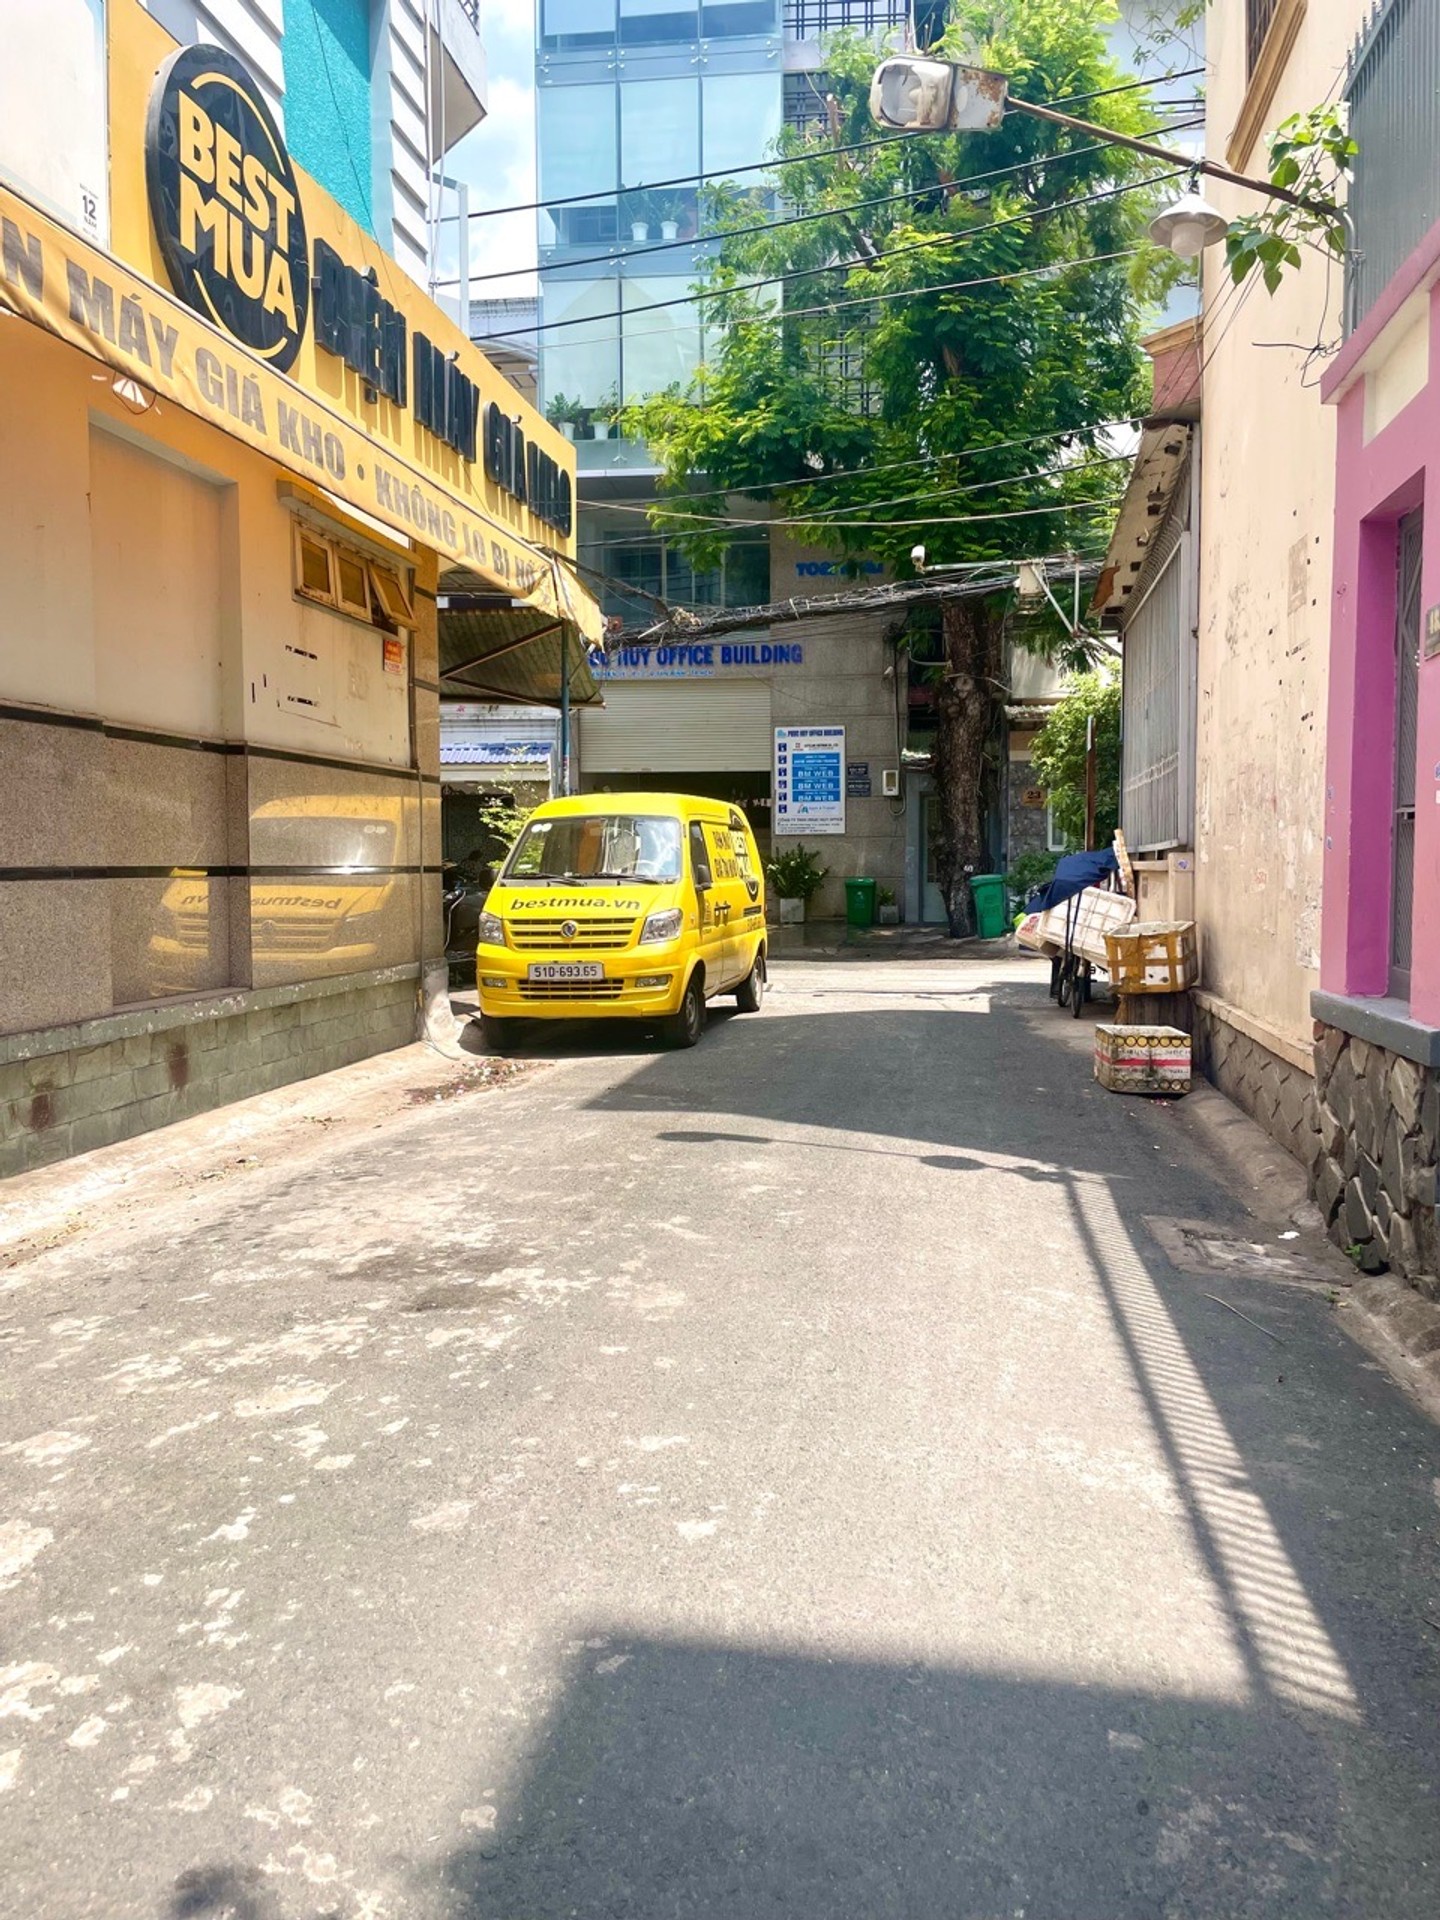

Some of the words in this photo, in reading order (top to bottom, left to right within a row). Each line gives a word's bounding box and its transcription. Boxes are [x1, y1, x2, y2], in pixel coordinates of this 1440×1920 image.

[179, 89, 295, 254] BEST
[83, 195, 97, 220] 12
[180, 171, 298, 334] MUA
[66, 257, 179, 379] MÁY
[195, 347, 267, 436] GIÁ
[277, 397, 346, 481] KHO
[374, 463, 457, 551] KHÔNG
[461, 521, 487, 566] LO
[491, 540, 510, 587] BỊ
[656, 645, 714, 666] OFFICE
[721, 644, 803, 665] BUILDING
[511, 898, 640, 910] bestmua.vn
[534, 966, 597, 978] 51D-693.65
